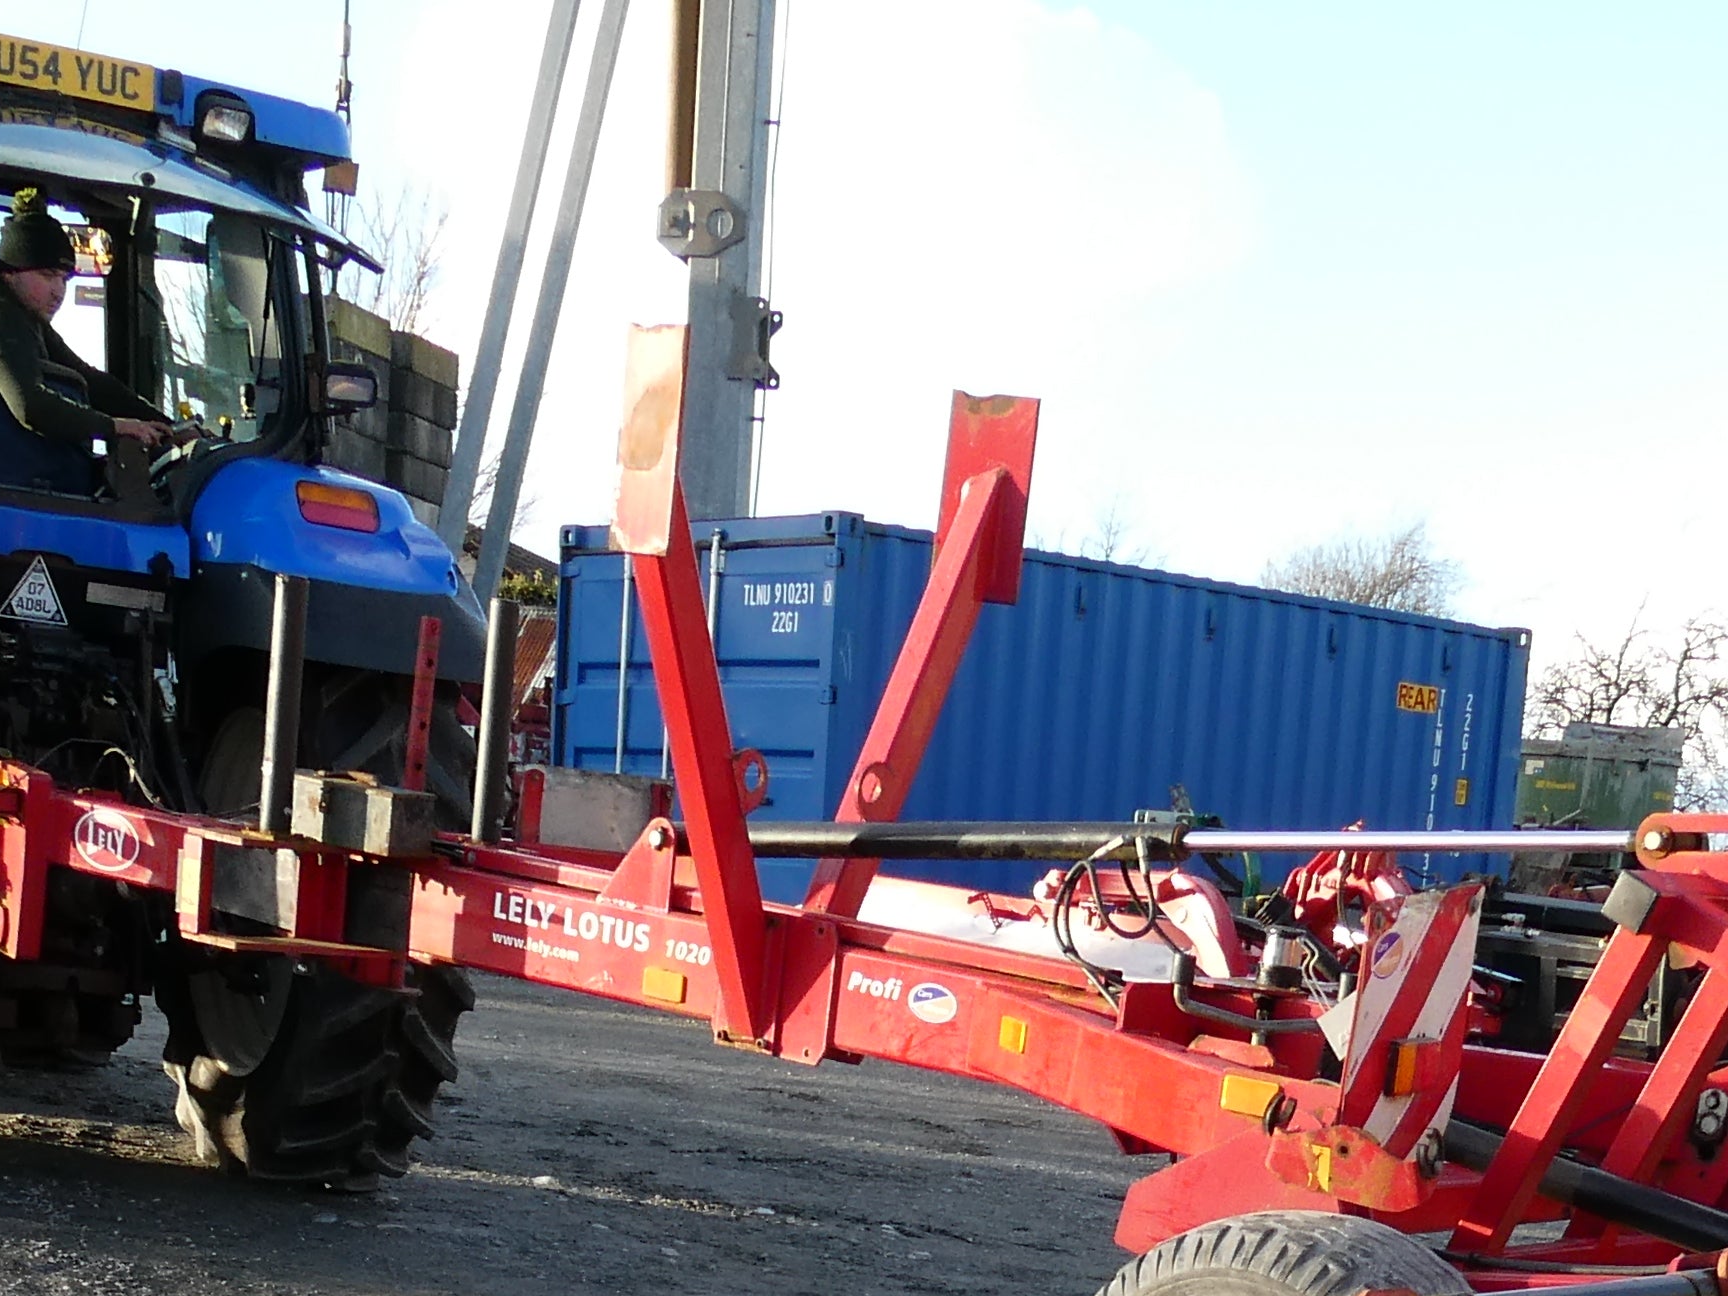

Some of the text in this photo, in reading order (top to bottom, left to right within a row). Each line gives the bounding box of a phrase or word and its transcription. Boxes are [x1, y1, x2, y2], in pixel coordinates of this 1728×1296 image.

[75, 55, 140, 101] YUC
[27, 581, 45, 596] 07
[744, 584, 771, 606] TLNU
[774, 582, 814, 605] 910231
[771, 611, 798, 633] 22G1
[1398, 683, 1438, 713] REAR
[1432, 688, 1447, 768] TLNU
[1460, 693, 1474, 771] 22G1
[85, 818, 126, 862] LELY
[493, 892, 712, 967] LELY LOTUS 1020
[492, 931, 580, 963] www.lely.com
[847, 970, 903, 1001] Profi
